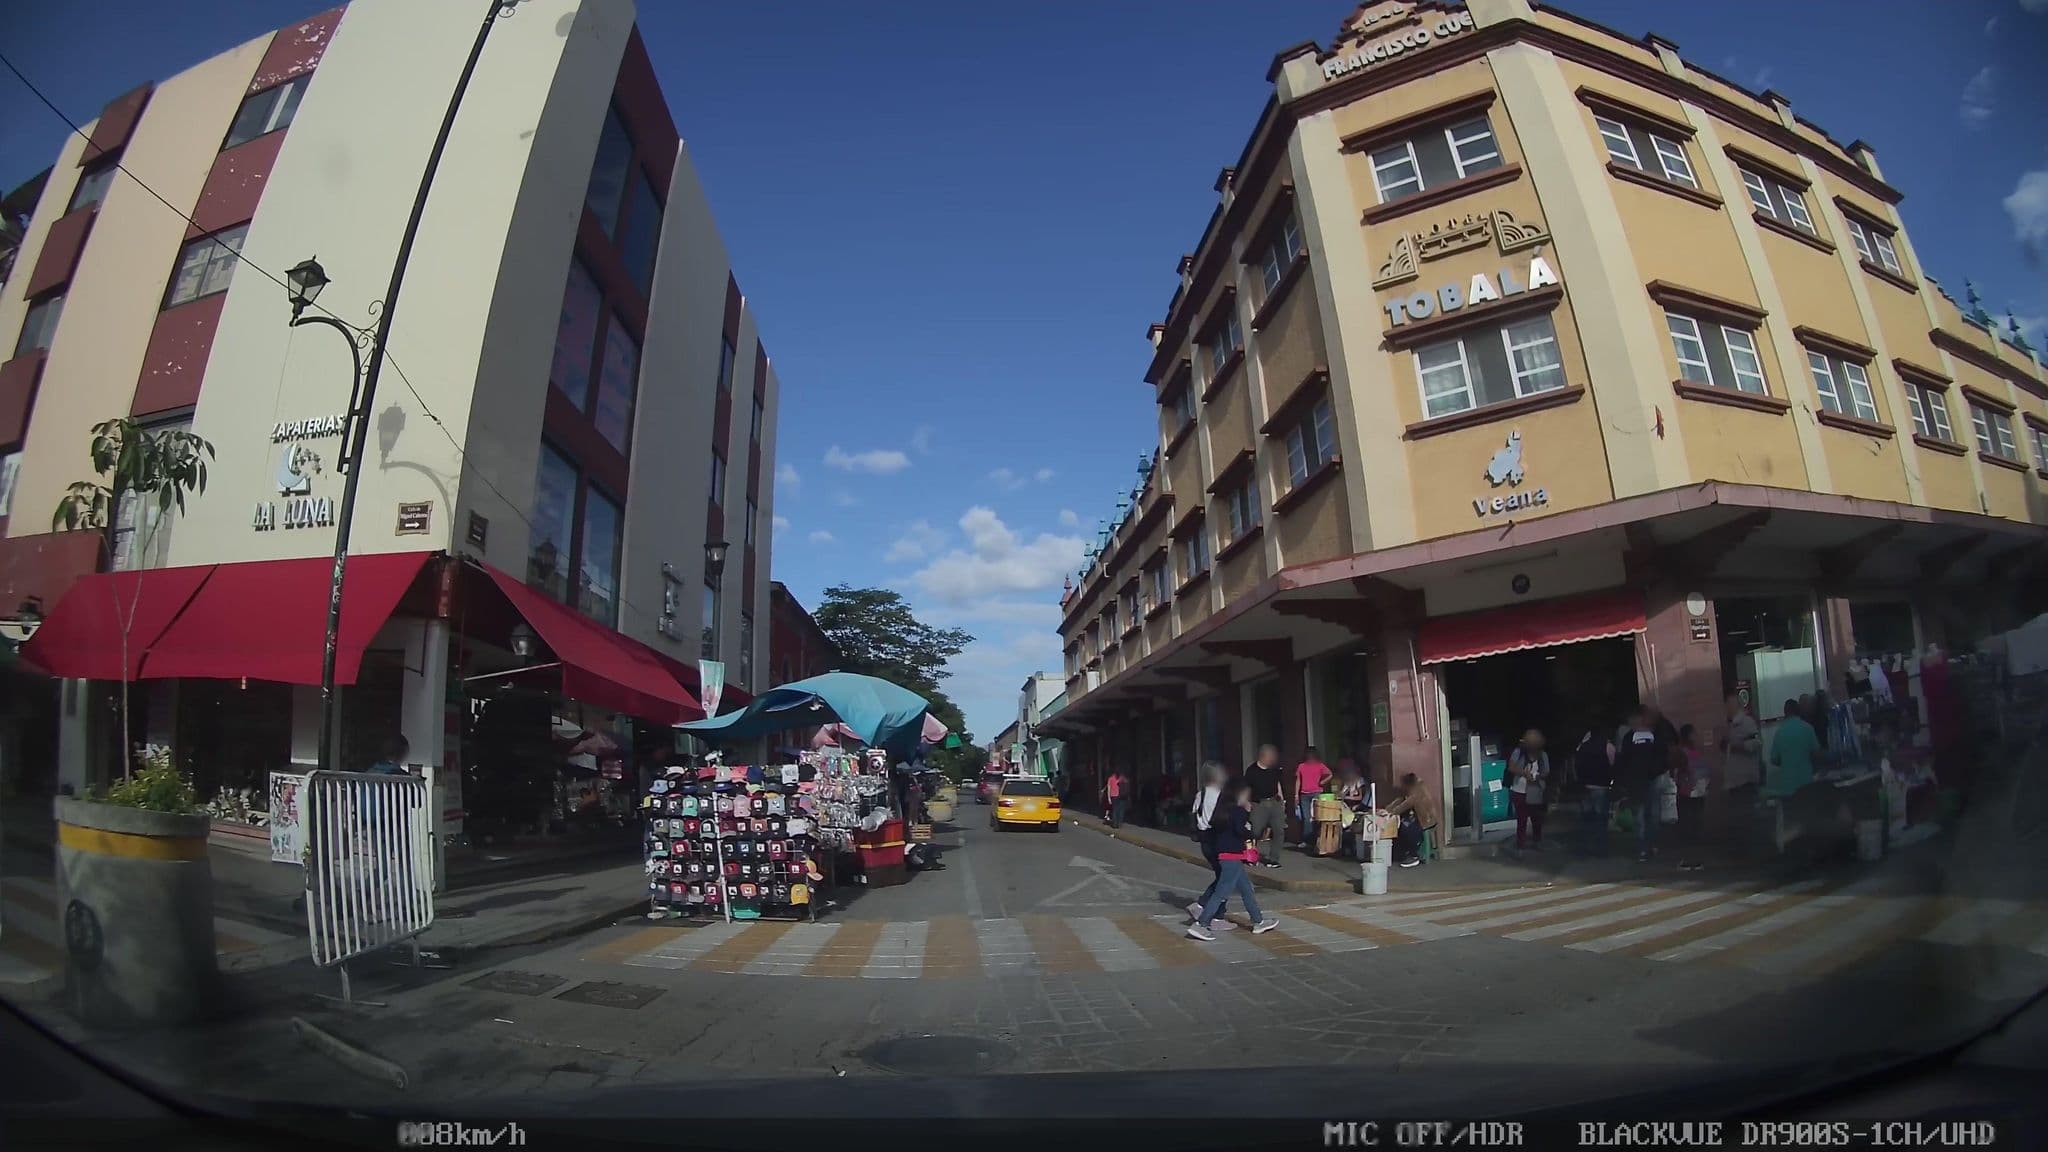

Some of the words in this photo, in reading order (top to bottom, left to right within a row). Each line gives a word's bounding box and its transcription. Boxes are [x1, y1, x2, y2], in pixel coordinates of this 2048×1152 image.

[1323, 28, 1431, 79] FRANCISCO
[271, 413, 346, 441] ZAPATERIAS
[253, 501, 275, 529] LA
[283, 496, 334, 527] LUNA
